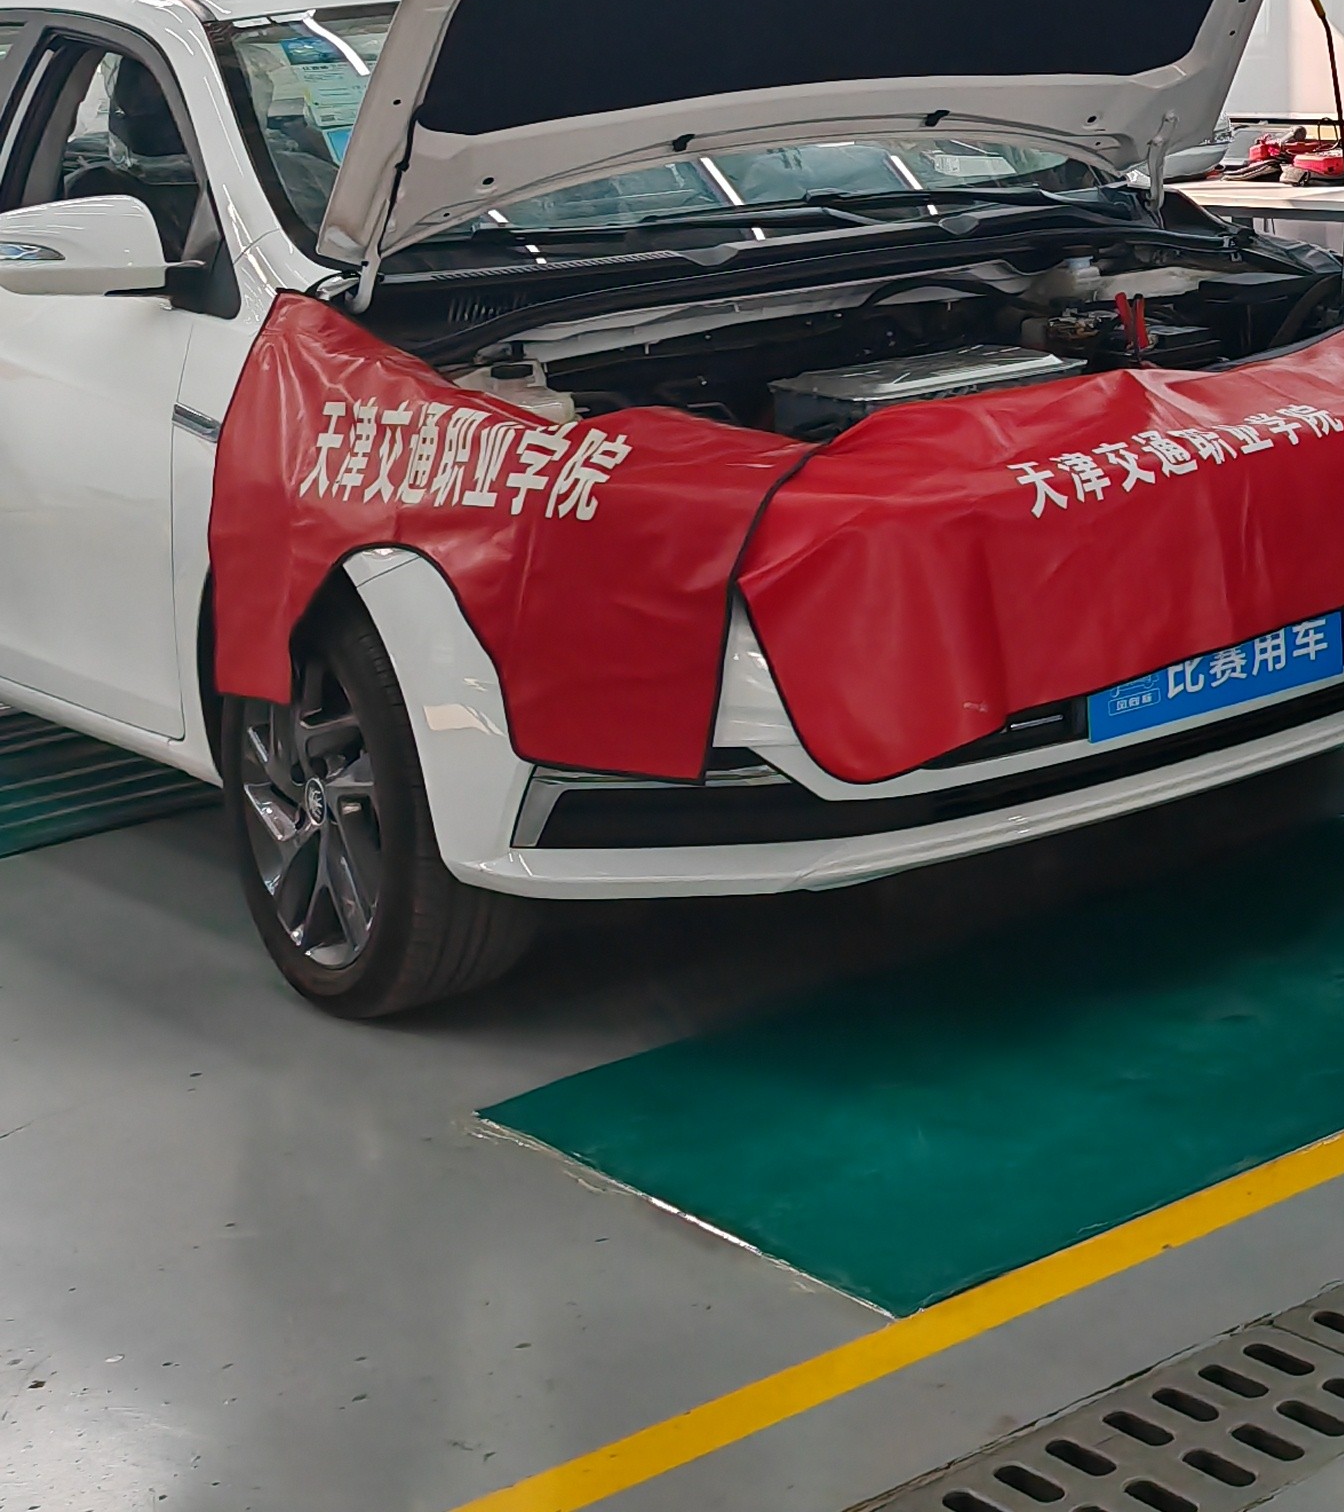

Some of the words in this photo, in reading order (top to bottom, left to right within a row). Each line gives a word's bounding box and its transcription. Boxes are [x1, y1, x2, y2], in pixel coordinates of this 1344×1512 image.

[300, 396, 633, 521] 天津交通职业学院
[1006, 403, 1344, 519] 天津交通职业学院
[1166, 618, 1329, 700] 比赛用车
